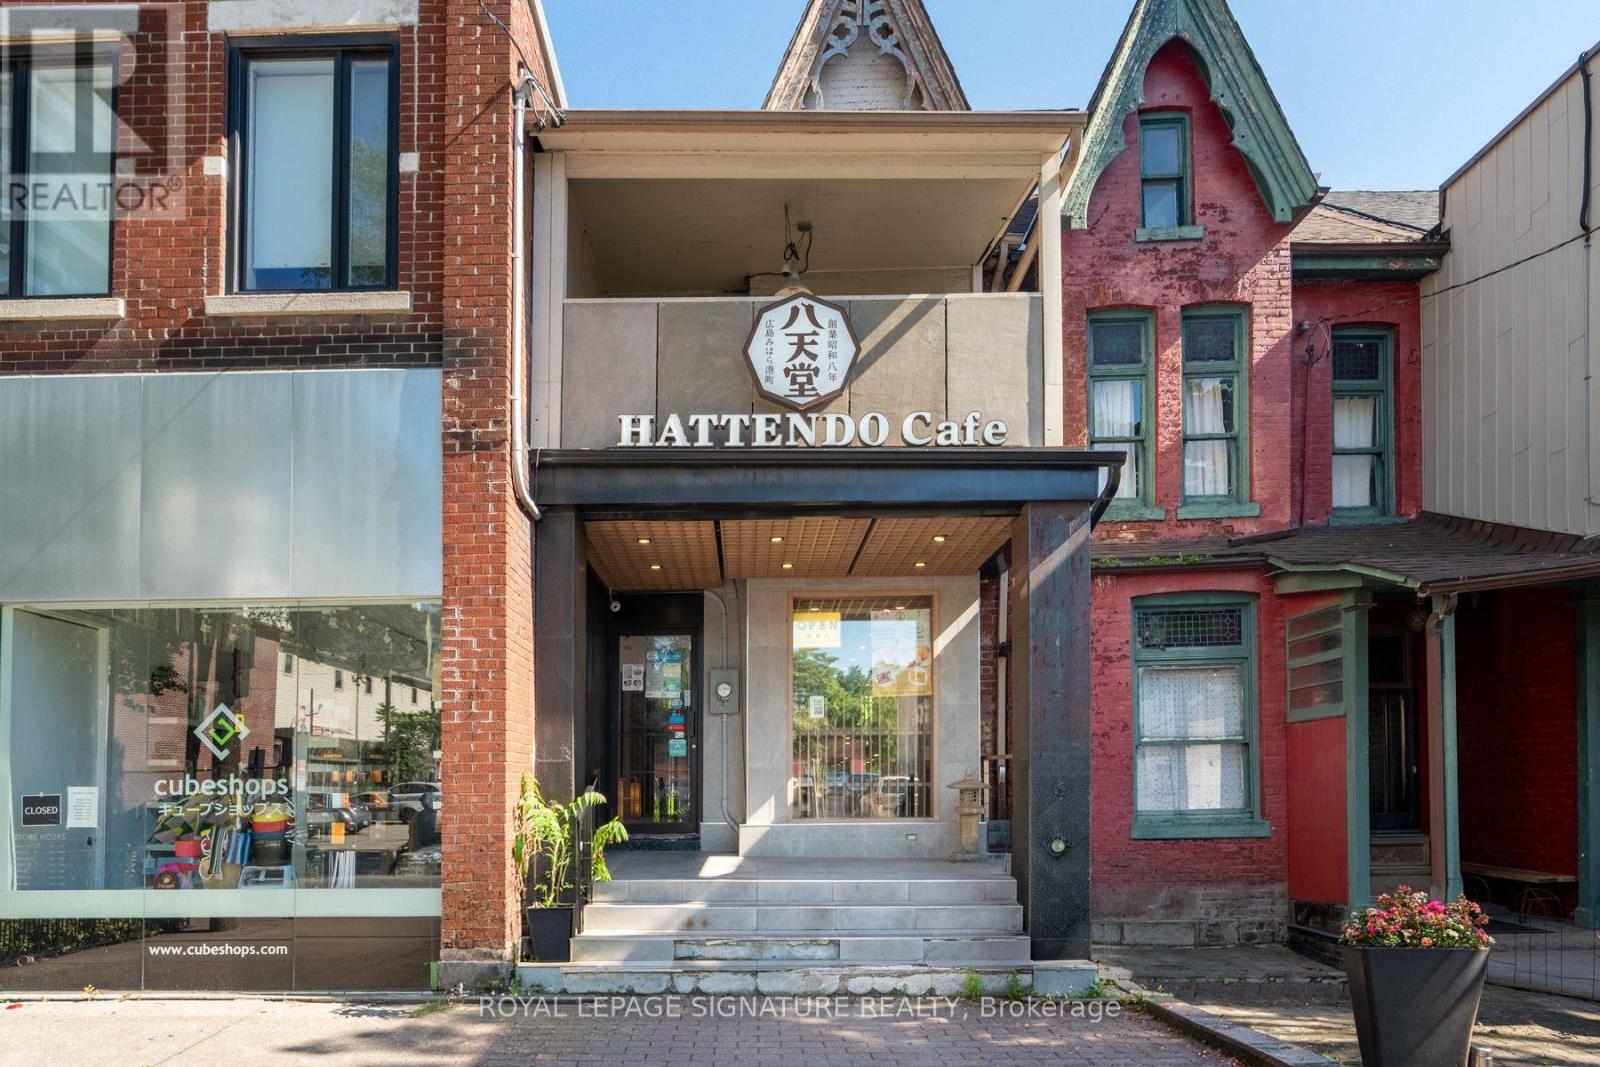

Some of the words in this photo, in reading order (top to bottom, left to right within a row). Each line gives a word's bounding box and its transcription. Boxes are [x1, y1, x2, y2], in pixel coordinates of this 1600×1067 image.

[780, 302, 826, 397] 八天堂
[827, 319, 838, 382] 創業昭和八年
[616, 412, 890, 447] HATTENDO
[901, 410, 1009, 447] Cafe
[796, 620, 838, 631] OPEN
[154, 773, 289, 800] cubeshops
[24, 806, 59, 815] CLOSED
[149, 943, 288, 957] www.cubeshops.com
